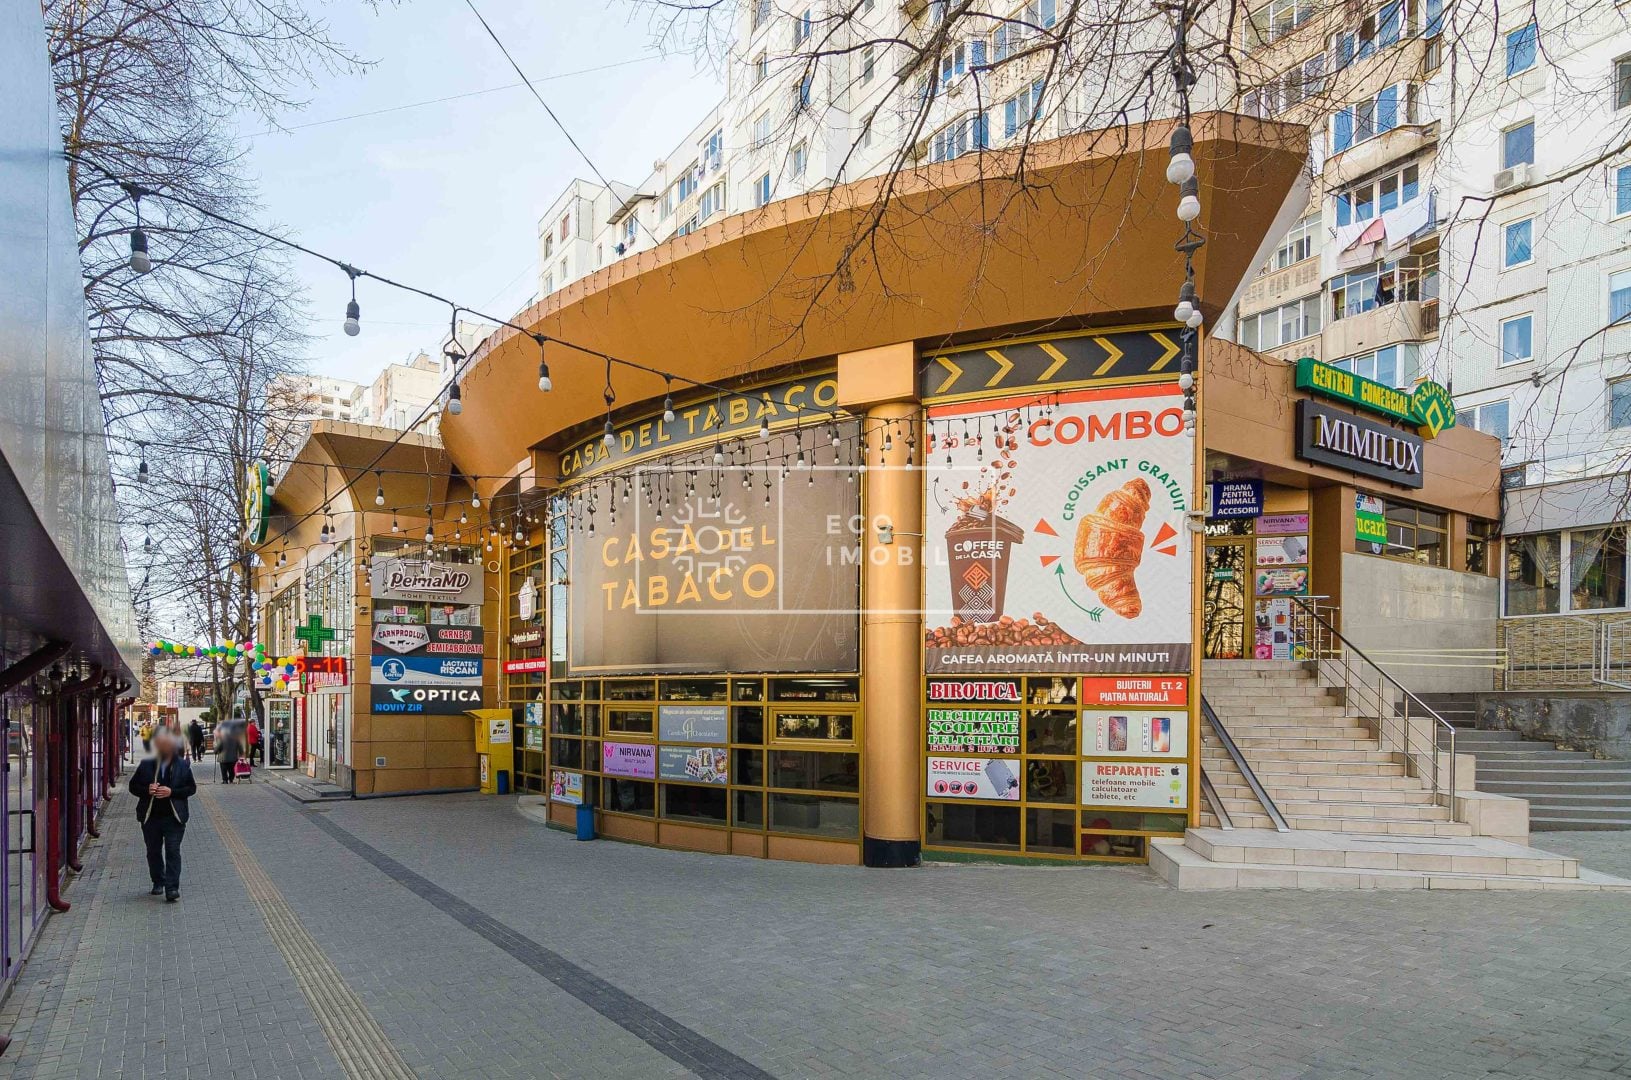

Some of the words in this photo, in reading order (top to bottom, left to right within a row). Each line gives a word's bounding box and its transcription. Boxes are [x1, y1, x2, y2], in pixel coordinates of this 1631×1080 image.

[1313, 363, 1354, 397] CENTRUL
[1361, 381, 1408, 416] COMERCIAL
[561, 441, 610, 476] CASA
[619, 425, 671, 453] DEL
[683, 379, 838, 432] TABACO
[1028, 407, 1185, 447] COMBO
[1319, 413, 1420, 474] MIMILUX
[1062, 458, 1128, 521] CROISSANT
[1138, 460, 1185, 512] GRATUIT
[1219, 497, 1256, 505] ANIMALE
[1217, 507, 1258, 515] ACCESORII
[602, 524, 701, 567] CASA
[718, 525, 775, 550] DEL
[954, 540, 1004, 552] COFFEE
[971, 550, 1002, 559] CASA
[602, 563, 775, 611] TABACO
[378, 629, 426, 641] CARNPRODLUX
[439, 629, 462, 639] CARNE
[427, 643, 484, 654] SEMIFABRICATE
[941, 654, 984, 665] CAFEA
[986, 651, 1054, 664] AROMATĂ
[1057, 650, 1115, 663] ÎNTR-UN
[1119, 652, 1170, 663] MINUT!
[930, 682, 1018, 700] BIROTICA
[1116, 680, 1152, 690] BIJUTERII
[1161, 682, 1173, 690] ET.
[1175, 682, 1183, 690] 2
[414, 689, 480, 701] OPTICA
[1100, 692, 1127, 702] PIATRA
[1128, 691, 1168, 702] NATURALĂ
[375, 703, 406, 711] NOVIY
[929, 710, 1019, 722] RECHIZITE
[929, 721, 1019, 736] ȘCOLARE
[928, 733, 1019, 746] FELICITĂRI
[619, 747, 652, 758] NIRVANA
[932, 761, 981, 771] SERVICE
[1096, 765, 1165, 777] REPARAȚIE:
